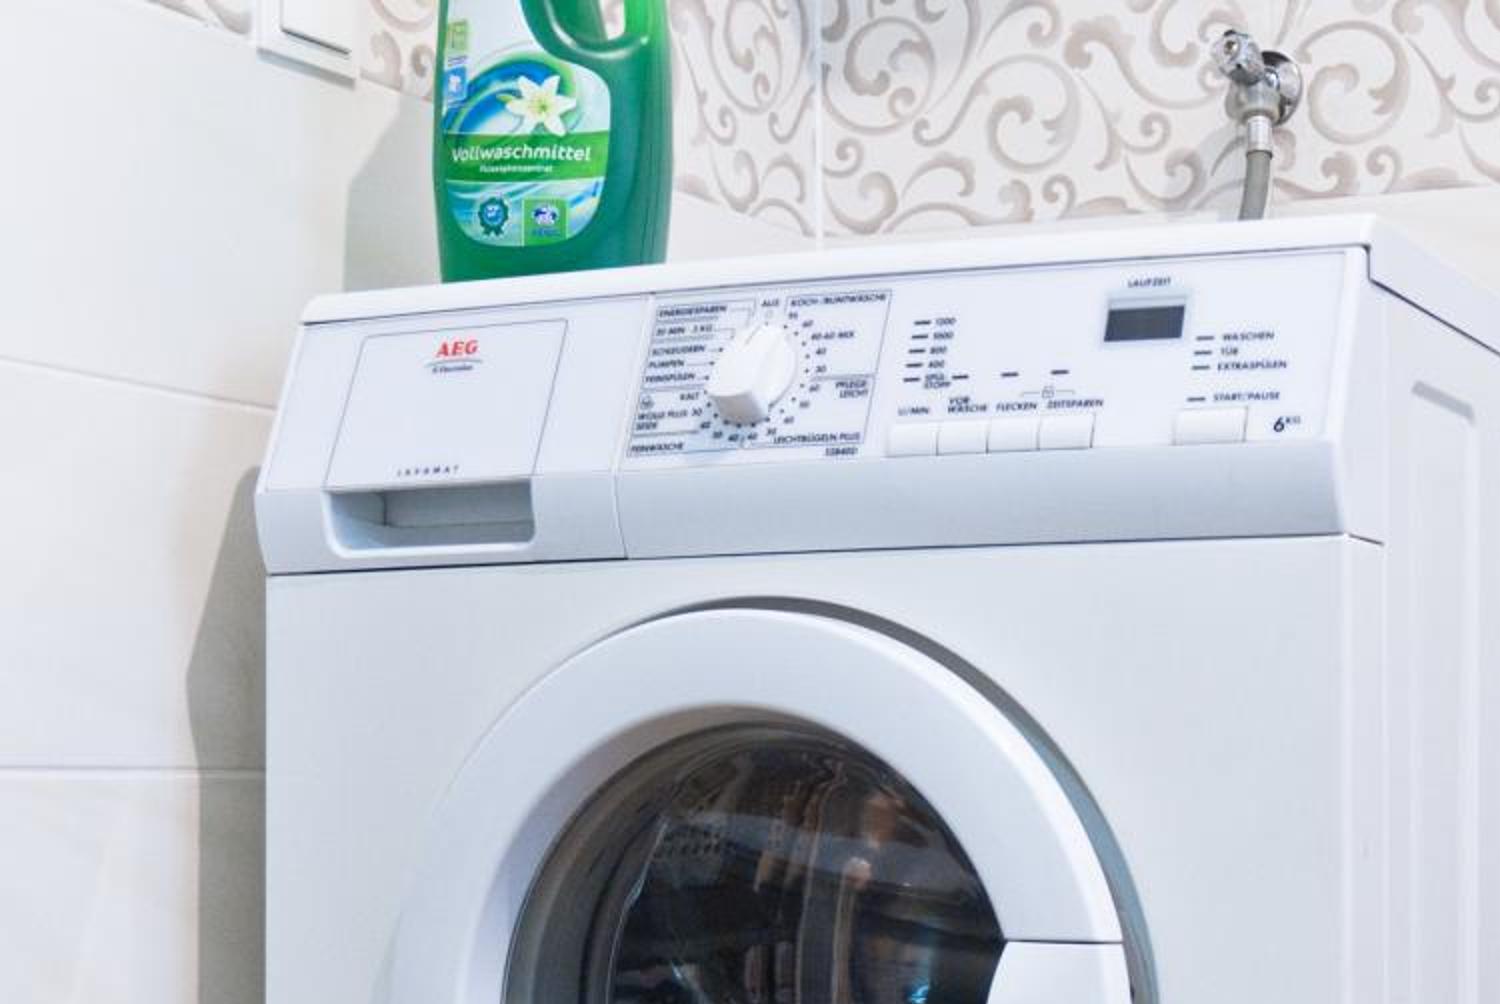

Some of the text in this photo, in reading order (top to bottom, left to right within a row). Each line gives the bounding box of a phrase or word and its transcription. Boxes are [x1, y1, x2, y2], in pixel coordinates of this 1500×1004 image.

[452, 144, 592, 162] Vollwaschmittel
[1128, 277, 1171, 288] LAUFZEIT
[1222, 331, 1275, 342] WASCHEN
[435, 339, 479, 358] AEG
[1220, 346, 1239, 356] TÜR
[1217, 359, 1288, 371] EXTRASPÜLEN
[996, 401, 1037, 412] FLECKEN
[1047, 399, 1103, 410] ZEITSPAREN
